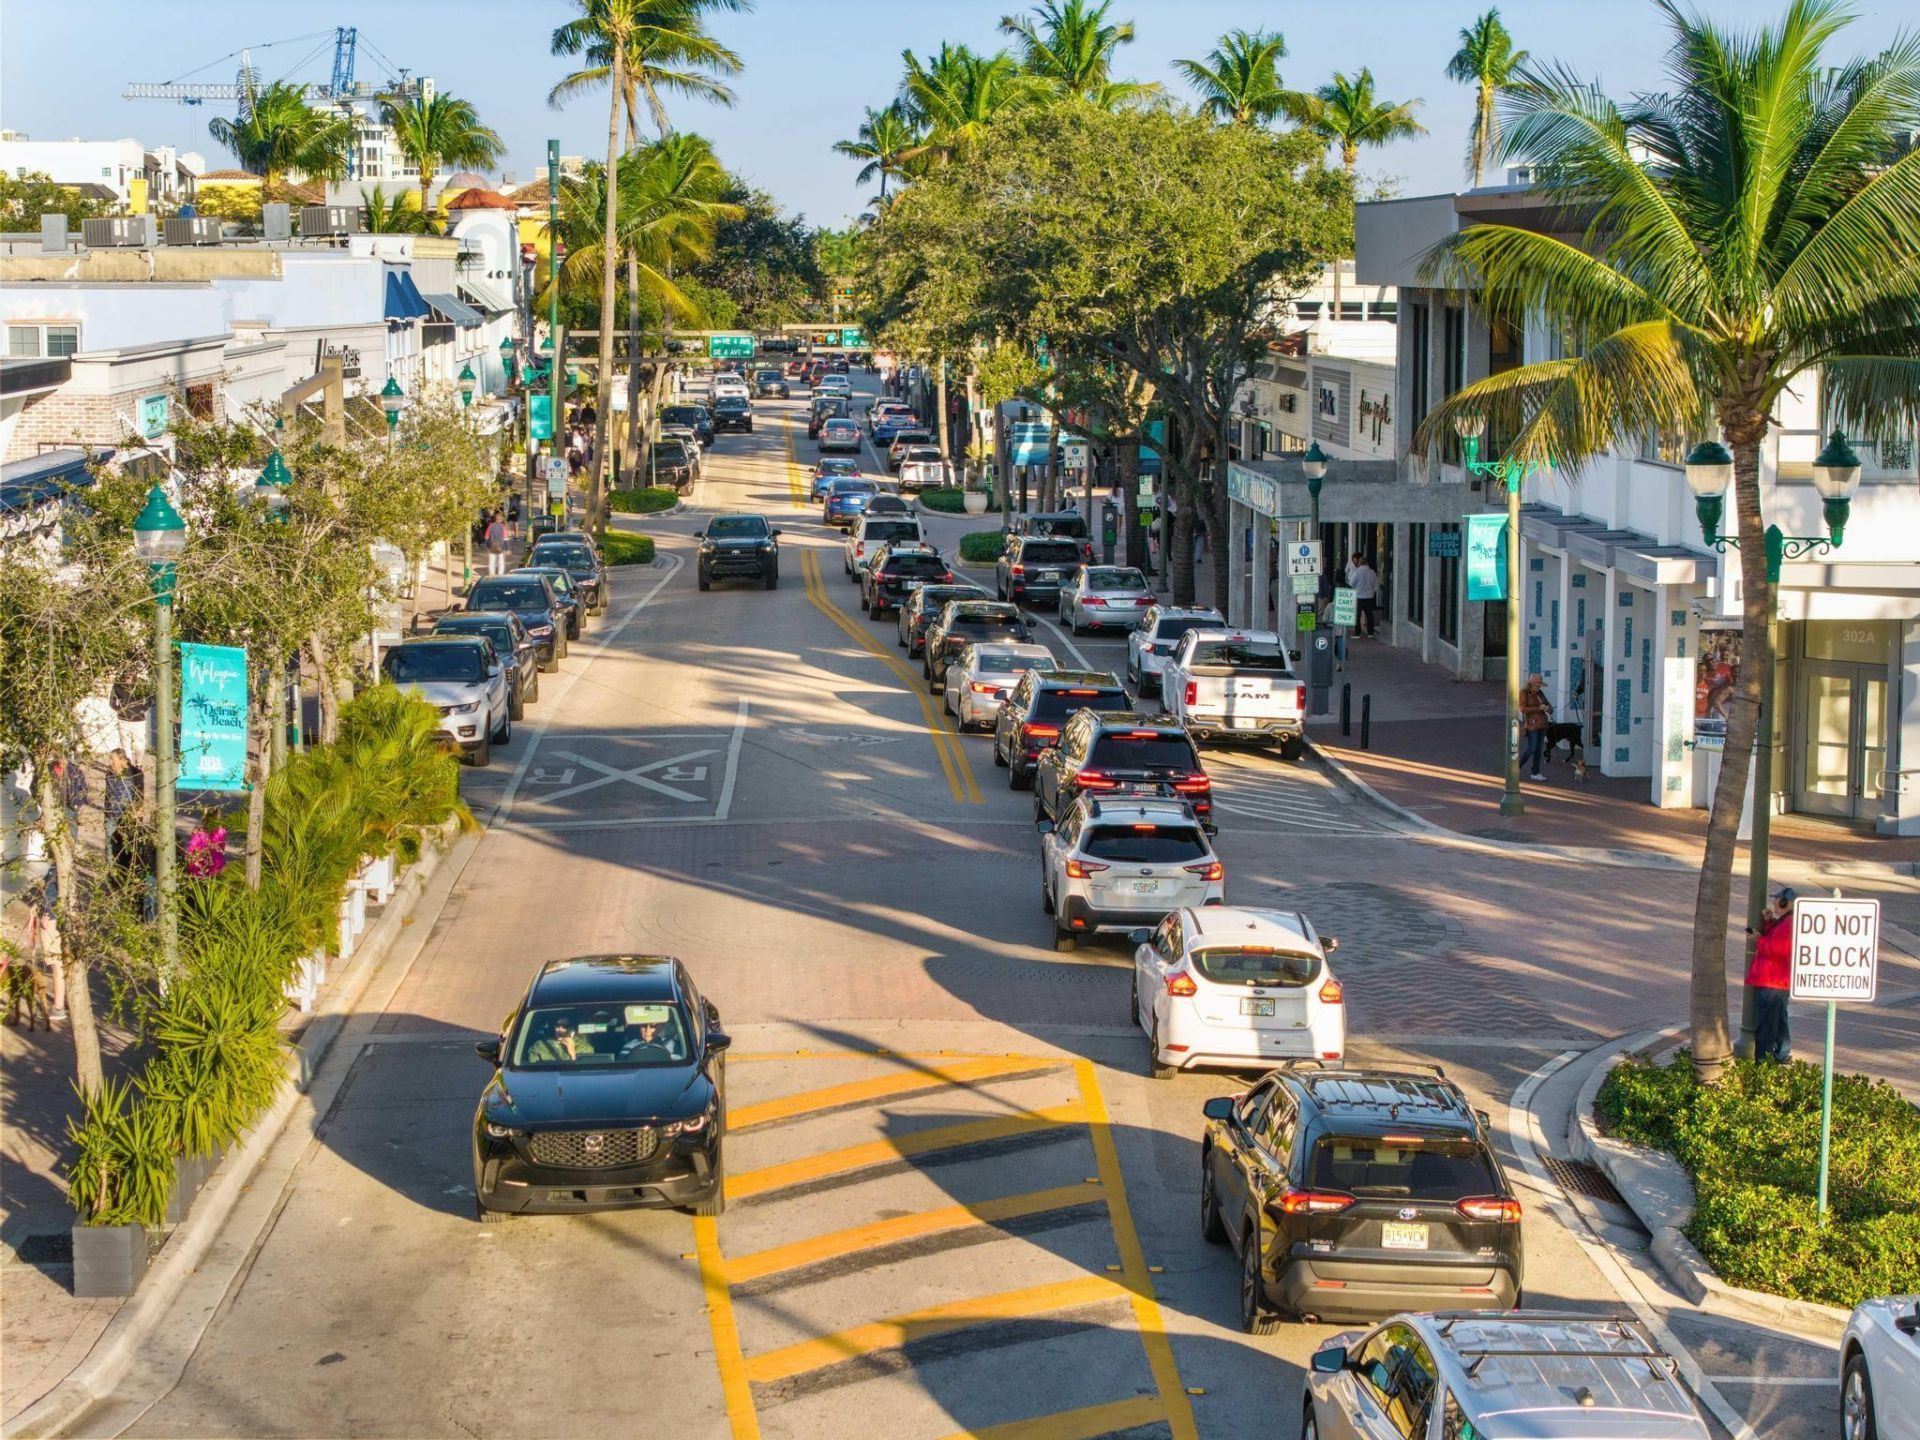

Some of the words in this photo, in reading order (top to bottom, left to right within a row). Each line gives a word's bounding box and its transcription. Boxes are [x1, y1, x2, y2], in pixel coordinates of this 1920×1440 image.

[487, 270, 512, 279] 401
[1842, 630, 1876, 644] 302A
[211, 715, 244, 729] Beach
[1800, 913, 1826, 935] DO
[1834, 914, 1872, 936] NOT
[1799, 945, 1871, 968] BLOCK
[1796, 973, 1870, 990] INTERSECTION
